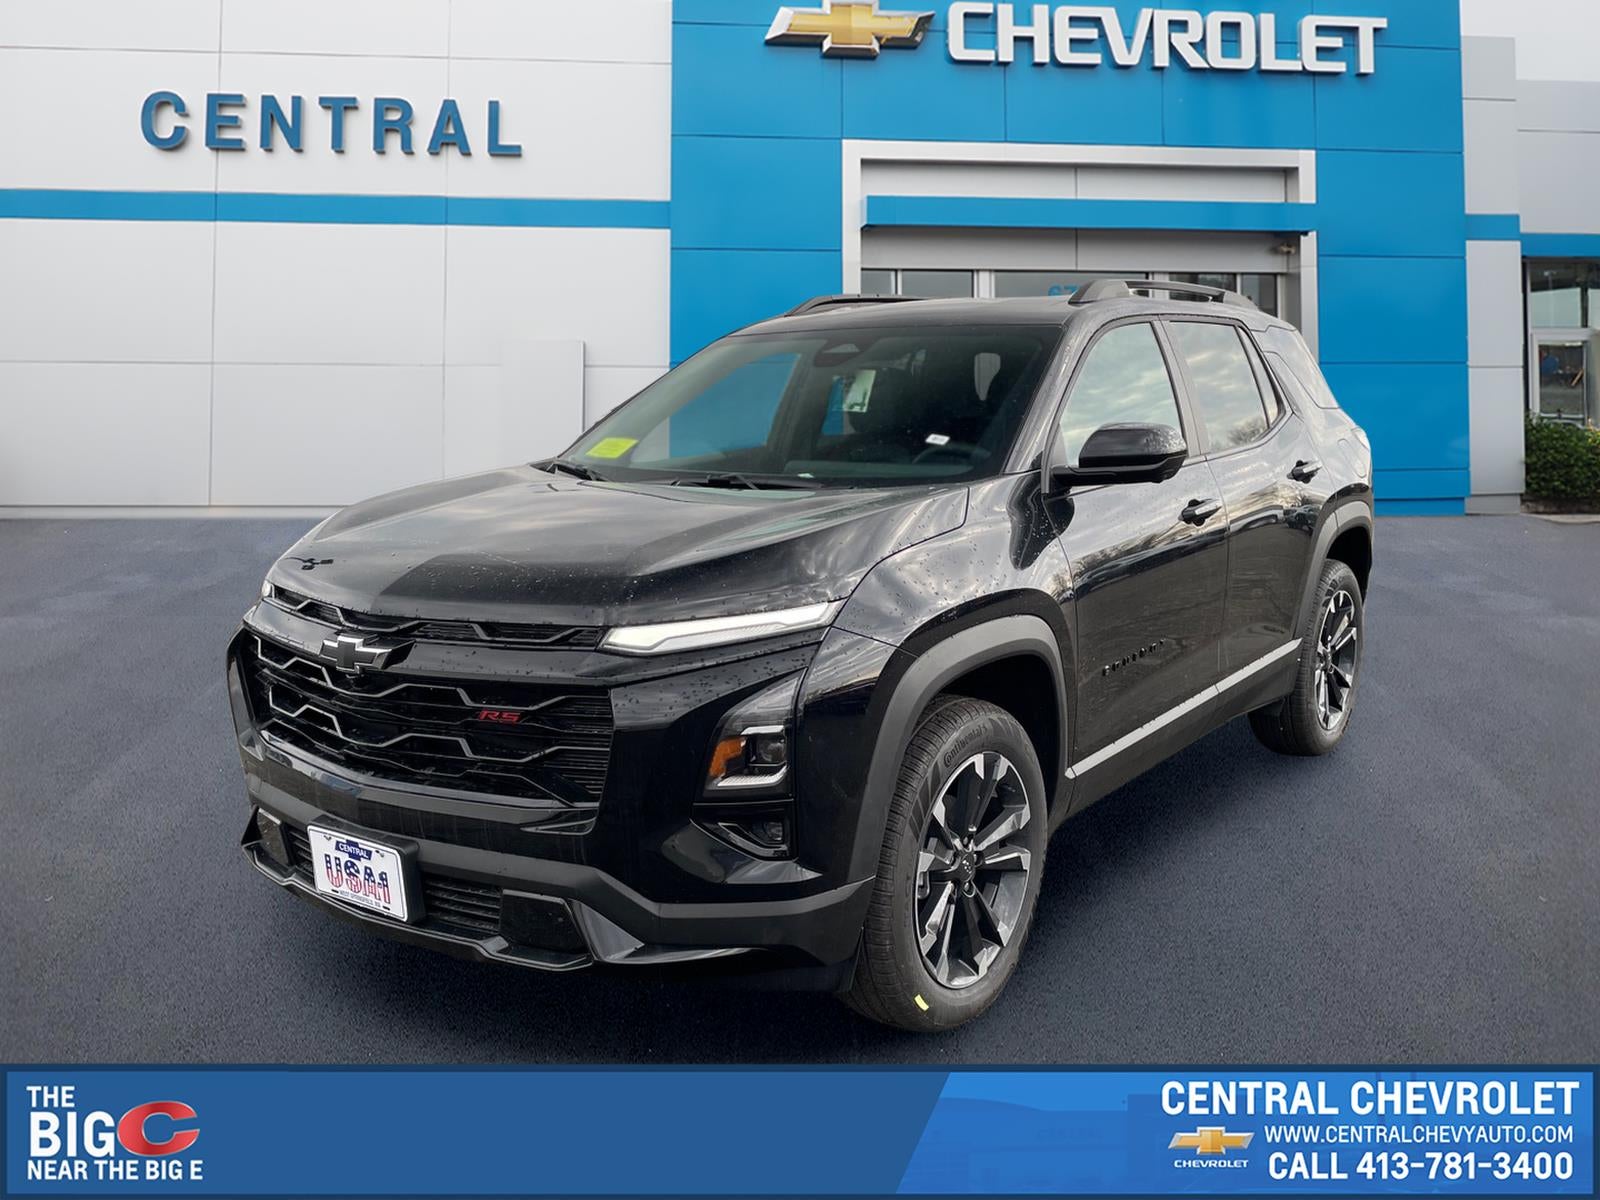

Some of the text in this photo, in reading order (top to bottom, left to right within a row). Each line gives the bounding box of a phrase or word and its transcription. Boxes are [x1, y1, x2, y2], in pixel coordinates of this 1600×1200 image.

[947, 0, 1388, 75] CHEVROLET
[140, 90, 524, 158] CENTRAL
[479, 708, 521, 724] RS
[338, 842, 369, 858] CENTRAL
